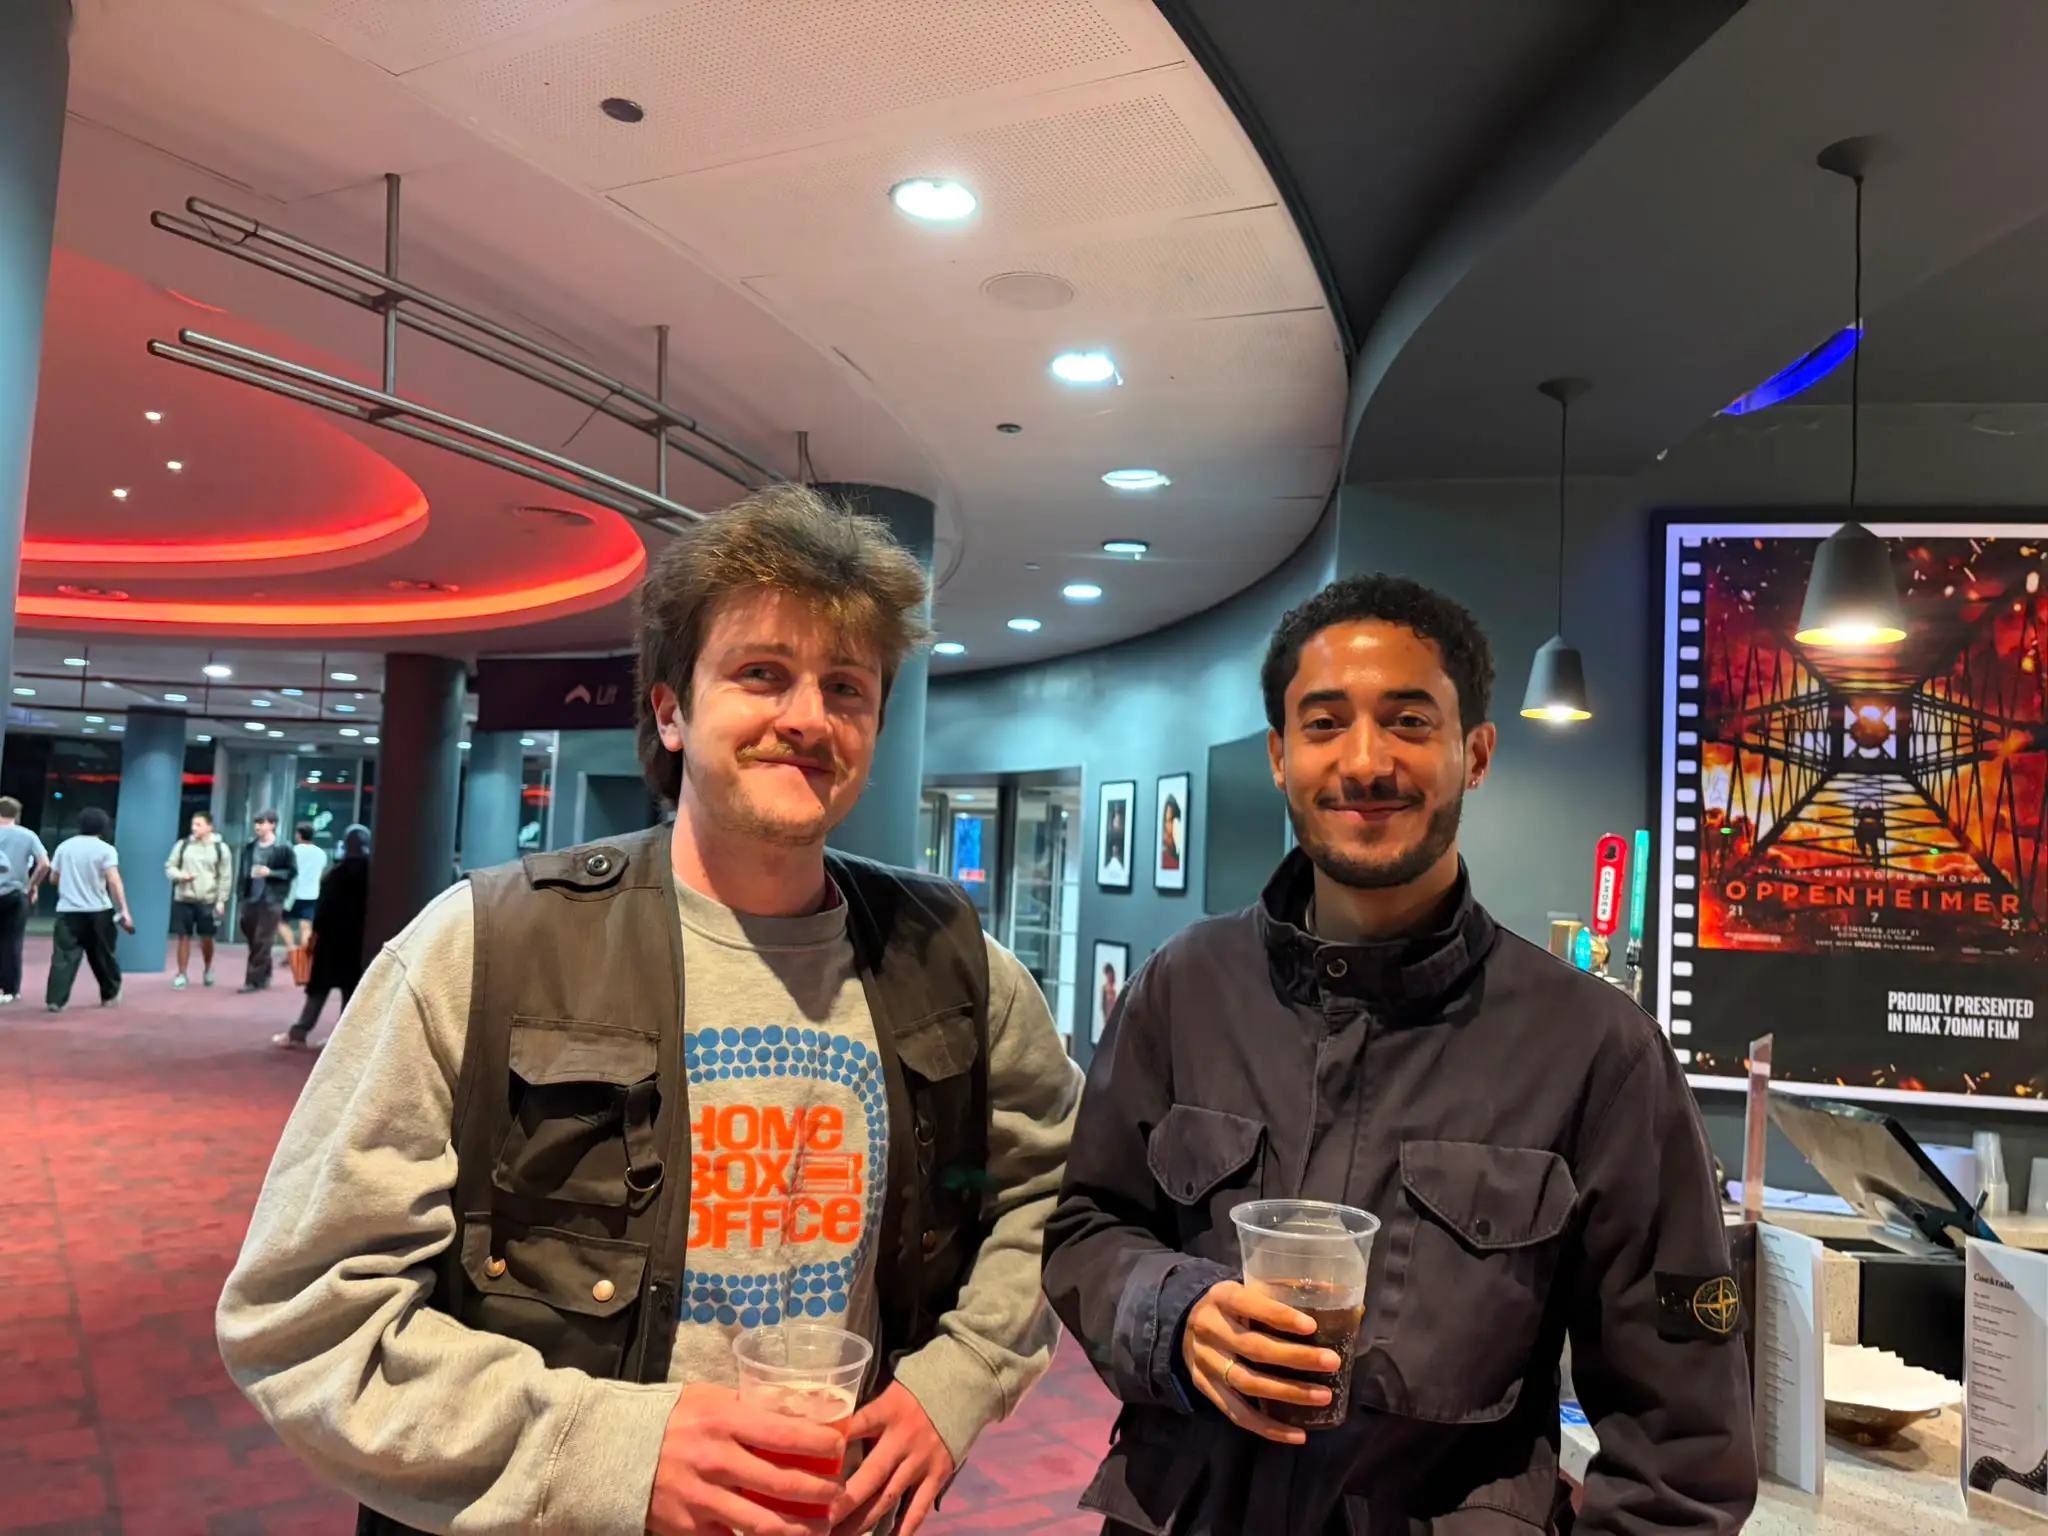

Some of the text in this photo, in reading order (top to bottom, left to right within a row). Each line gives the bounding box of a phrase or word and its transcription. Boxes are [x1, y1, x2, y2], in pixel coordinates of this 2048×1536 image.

[1937, 874, 1992, 885] NOLAN
[1600, 871, 1611, 916] CAMDEN
[1726, 881, 2020, 914] OPPENHEIMER
[1728, 904, 1743, 917] 21
[1871, 911, 1879, 923] 7
[1886, 928, 1906, 936] JULY
[2001, 918, 2021, 931] 23
[1888, 990, 2034, 1019] PROUDLY PRESENTED
[1887, 1012, 2020, 1040] IN IMAX 70MM FILM
[1973, 1272, 2015, 1291] Cocktails
